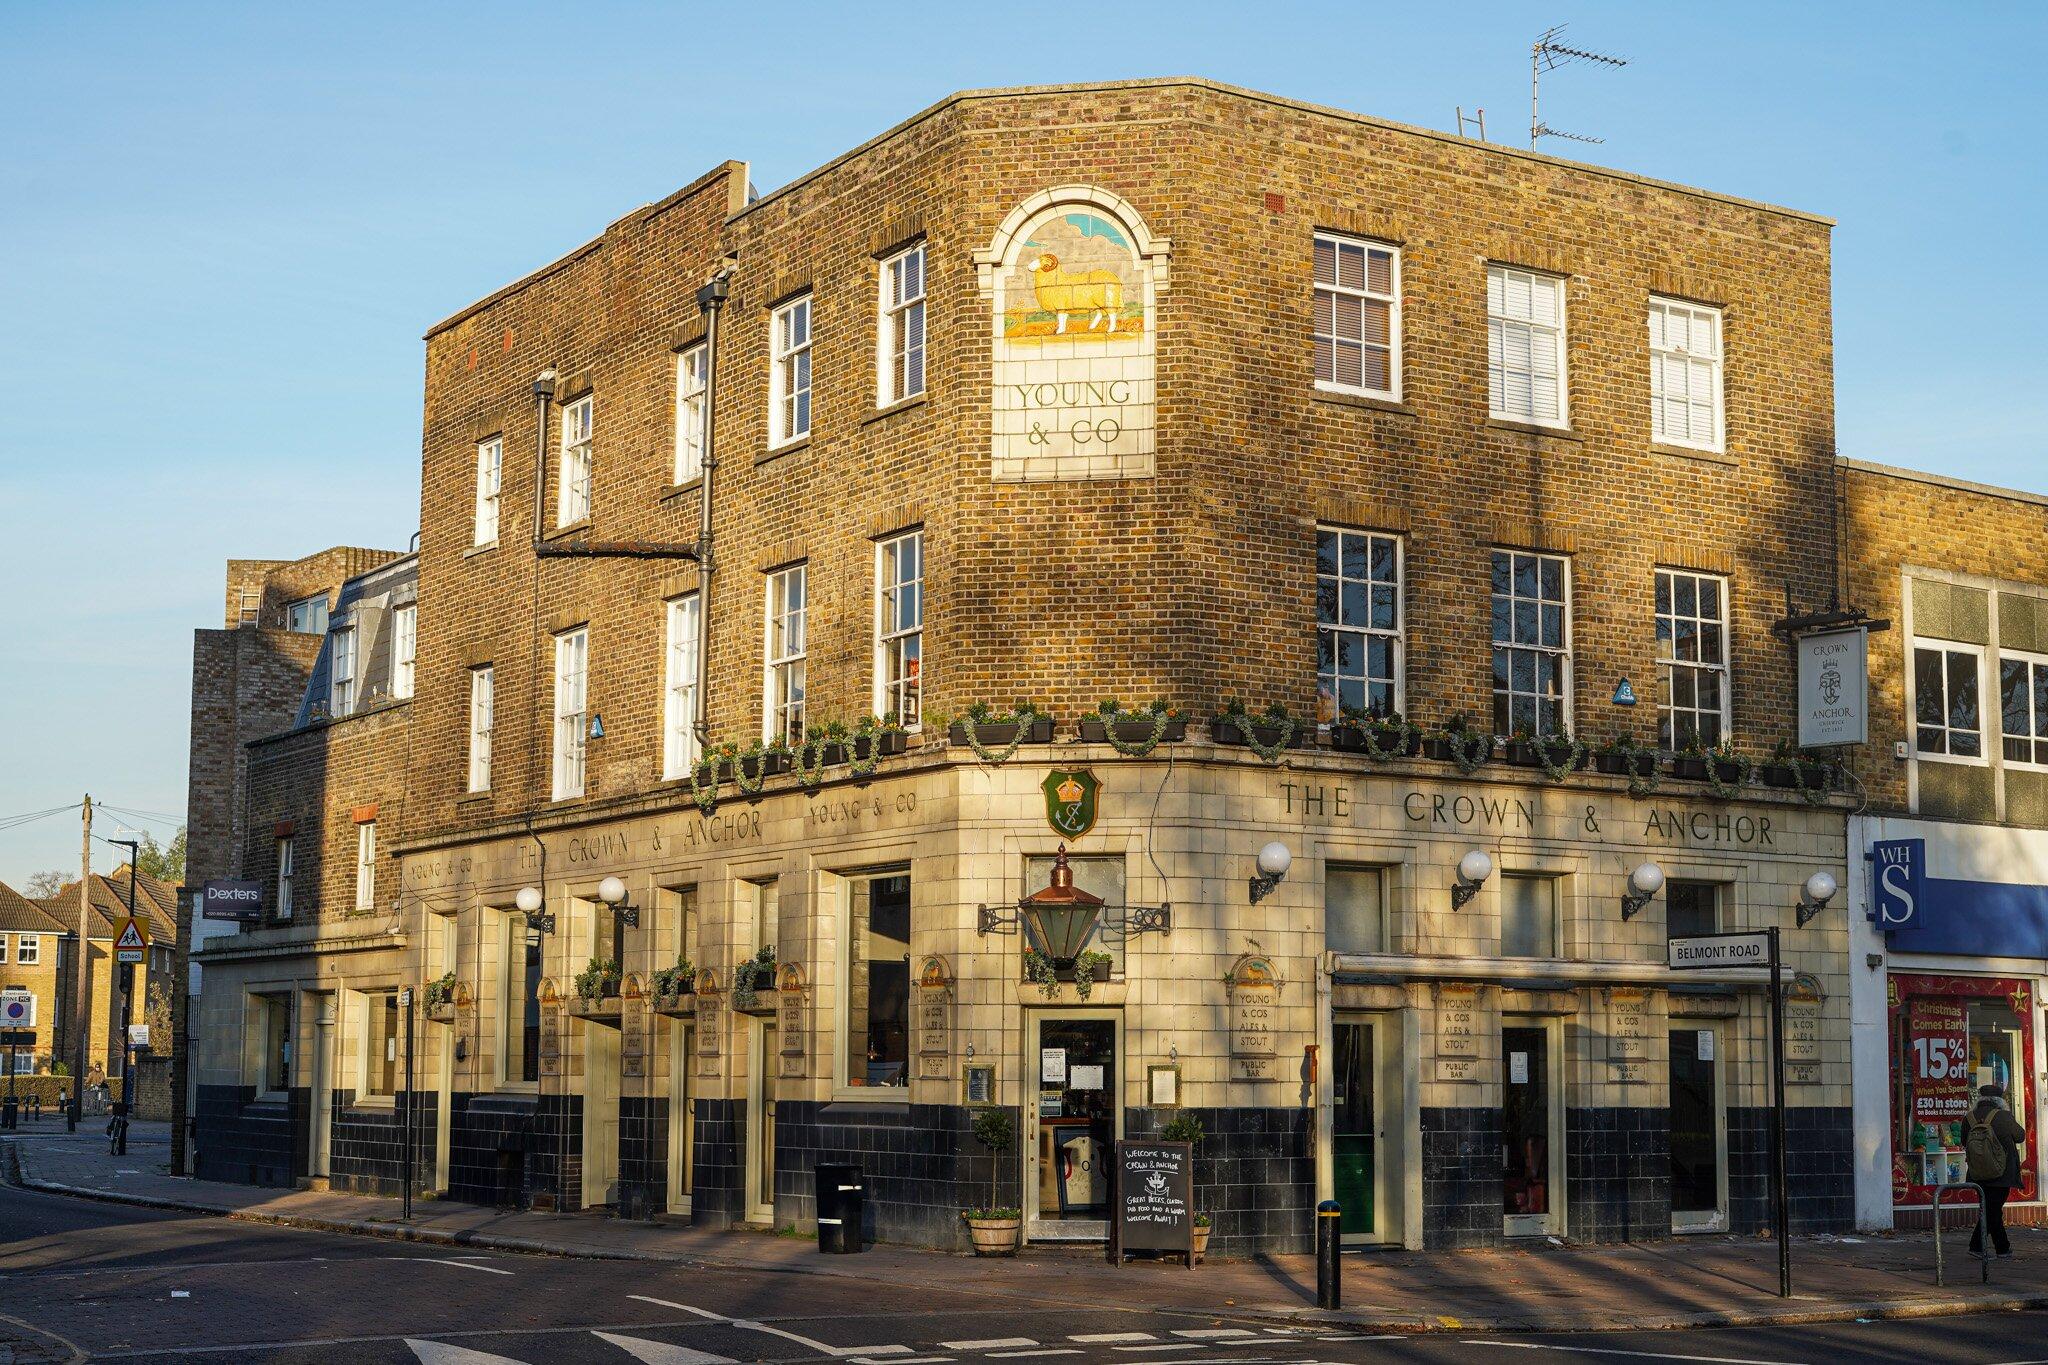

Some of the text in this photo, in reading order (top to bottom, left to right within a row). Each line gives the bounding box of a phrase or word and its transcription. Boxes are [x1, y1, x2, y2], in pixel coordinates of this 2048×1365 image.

[1014, 380, 1130, 407] YOUNG
[1029, 418, 1120, 445] & CO
[1813, 643, 1849, 657] CROWN
[1812, 707, 1856, 719] ANCHOR
[810, 792, 917, 825] YOUNG & CO
[1279, 784, 1773, 844] THE CROWN & ANCHOR
[520, 810, 762, 869] TH CROWN & ANCHOR
[1880, 846, 1911, 863] WH
[411, 858, 472, 880] YOUNG & CO
[208, 887, 258, 900] Dexters
[1882, 864, 1914, 923] S
[1677, 944, 1760, 960] BELMONT ROAD
[1240, 994, 1270, 1004] YOUNG
[1444, 1000, 1472, 1008] YOUNG
[1615, 1003, 1640, 1012] YOUNG
[1791, 1008, 1815, 1016] YOUNG
[1917, 1002, 1962, 1017] Christmas
[1241, 1009, 1247, 1017] &
[1445, 1013, 1451, 1021] &
[1616, 1017, 1622, 1025] &
[1912, 1019, 1967, 1031] Comes Early
[1239, 1022, 1268, 1032] ALES &
[1444, 1027, 1471, 1035] ALES &
[1615, 1030, 1640, 1039] ALES &
[1240, 1037, 1268, 1046] STOUT
[1445, 1040, 1469, 1049] STOUT
[1616, 1042, 1639, 1051] STOUT
[1793, 1045, 1813, 1054] STOUT
[1240, 1061, 1266, 1069] PUBLIC
[1246, 1069, 1260, 1077] BAR
[1949, 1062, 1968, 1079] off
[1916, 1085, 1968, 1096] When You Spend
[1917, 1097, 1967, 1108] £30 in store
[1125, 1149, 1158, 1158] WELCOME
[1125, 1161, 1148, 1169] CROWN
[1156, 1162, 1178, 1170] ANCHOR
[1126, 1195, 1146, 1205] GREAT
[1171, 1207, 1186, 1215] WARM
[1126, 1214, 1152, 1222] WELCOME
